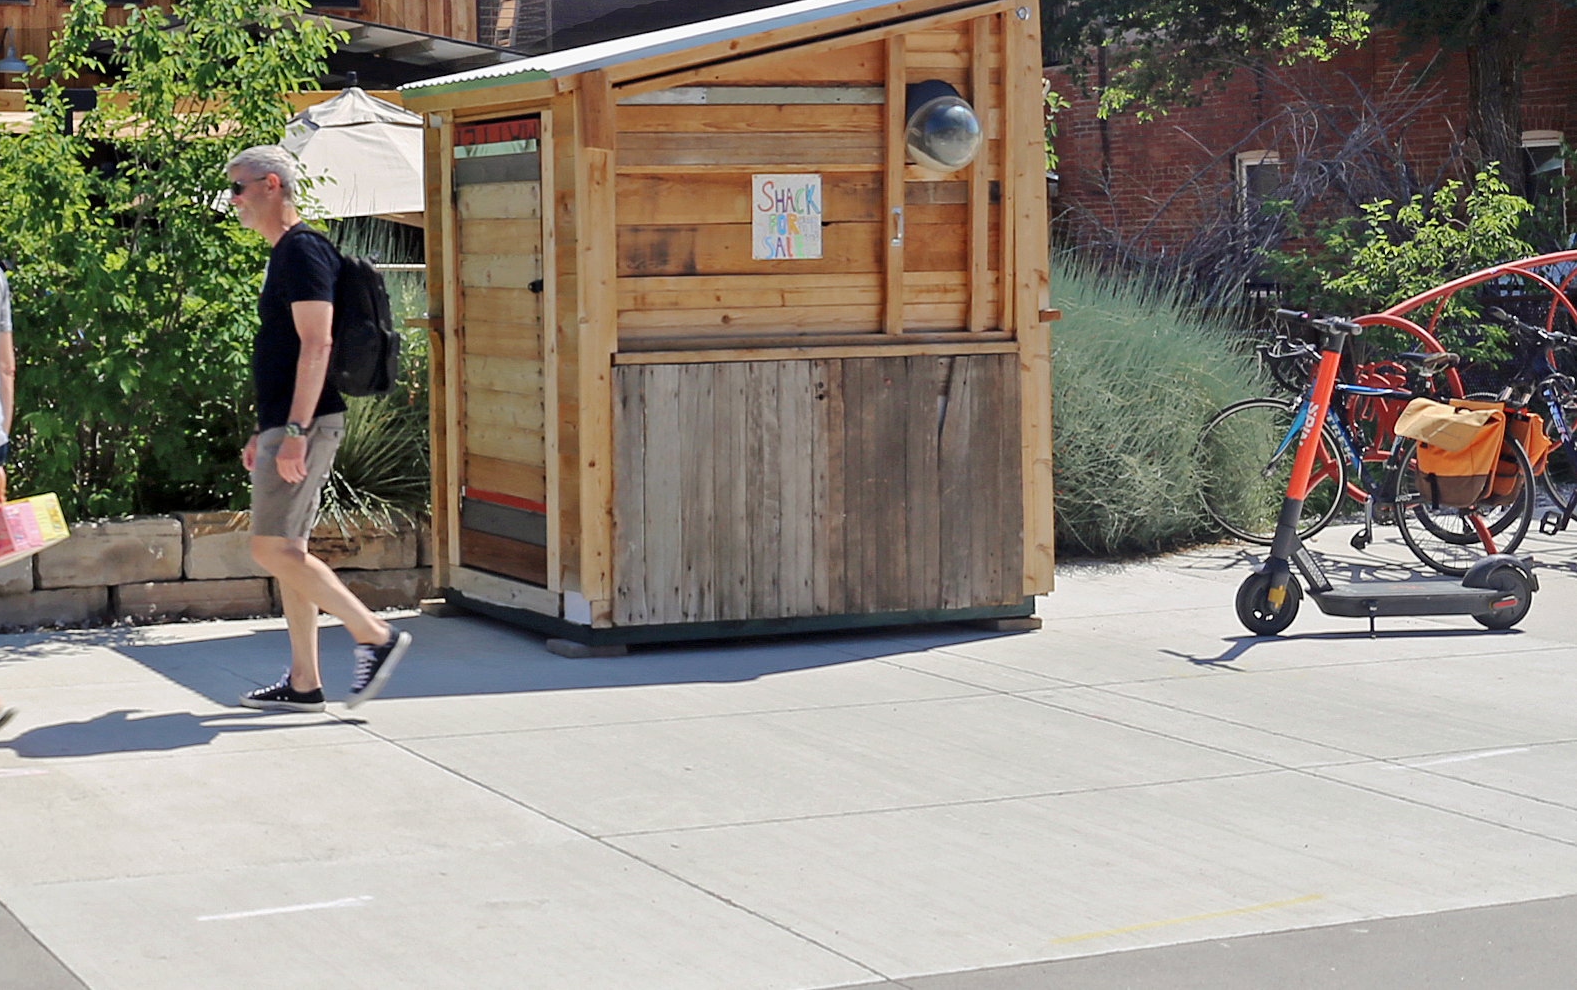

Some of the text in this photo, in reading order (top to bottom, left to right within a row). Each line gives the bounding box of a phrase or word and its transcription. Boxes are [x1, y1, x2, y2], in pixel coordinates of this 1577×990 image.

[757, 180, 821, 215] SHACK
[769, 214, 800, 235] FOR
[764, 234, 805, 260] SALE
[1325, 411, 1356, 459] TREK
